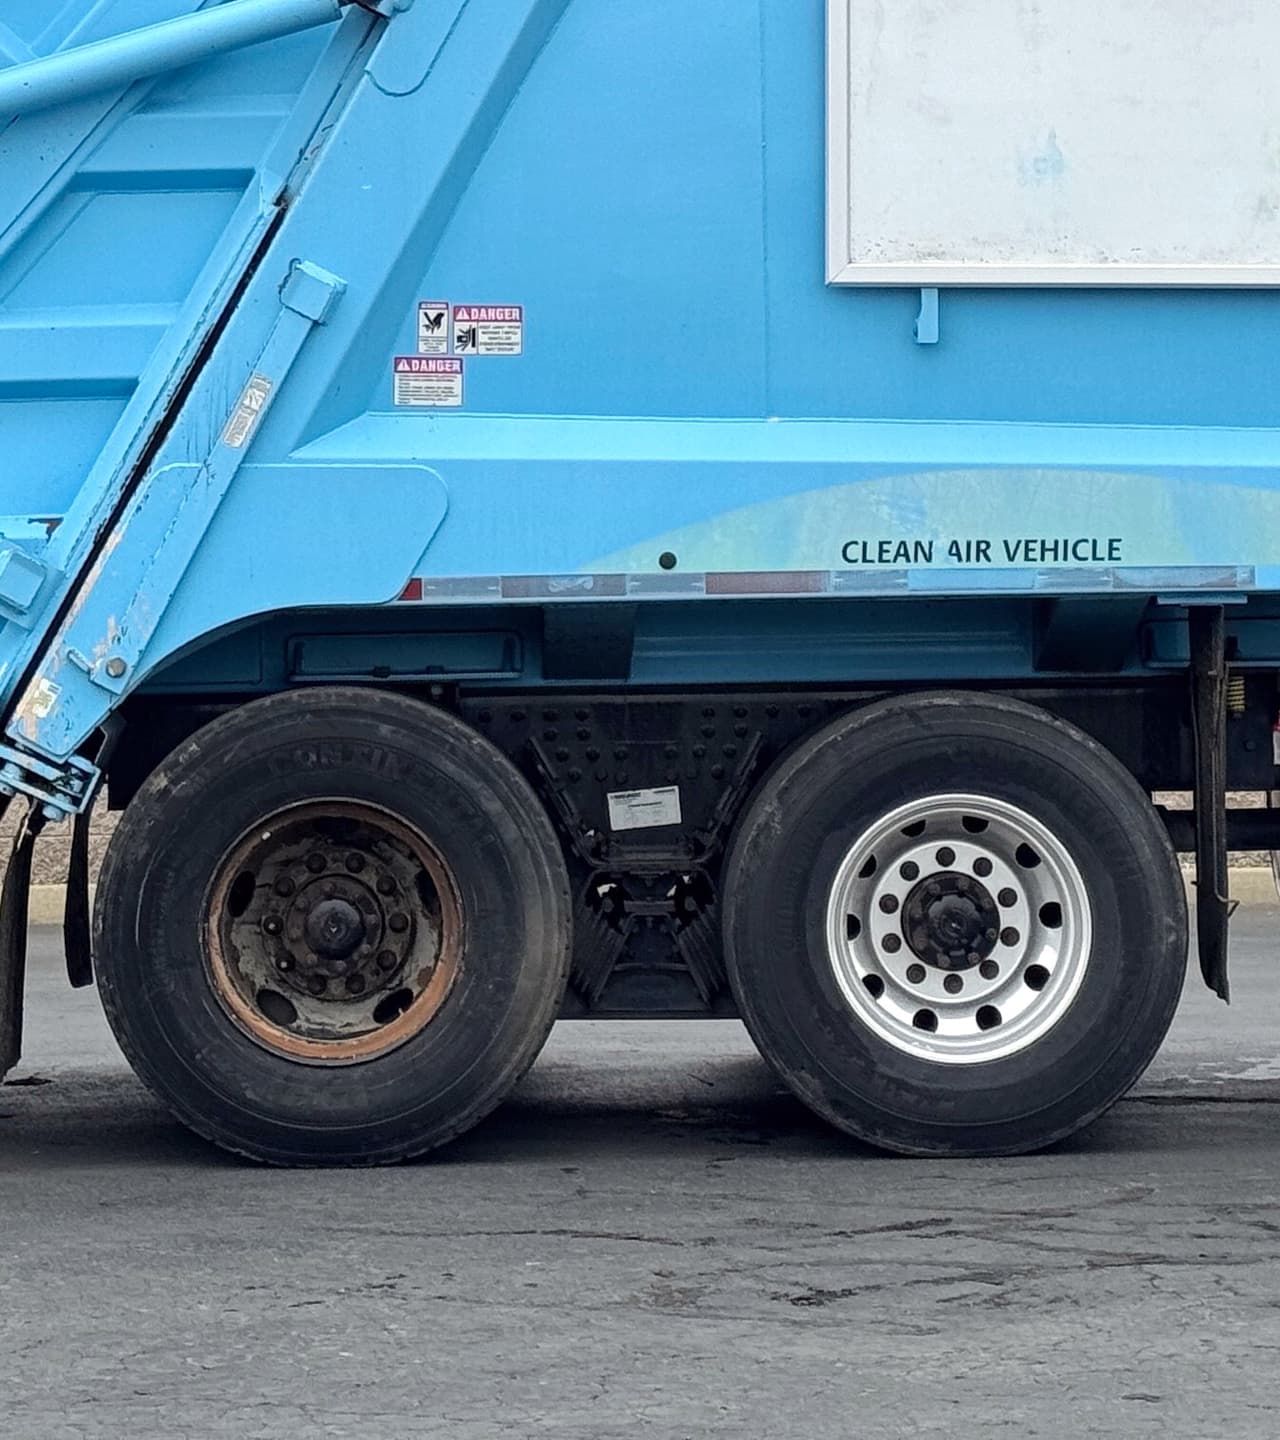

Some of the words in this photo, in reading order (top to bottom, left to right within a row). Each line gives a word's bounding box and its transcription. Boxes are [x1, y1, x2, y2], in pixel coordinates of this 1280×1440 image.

[471, 308, 520, 320] DANGER
[411, 360, 460, 372] DANGER
[841, 540, 934, 564] CLEAN
[948, 539, 992, 563] AIR
[1003, 538, 1123, 562] VEHICLE
